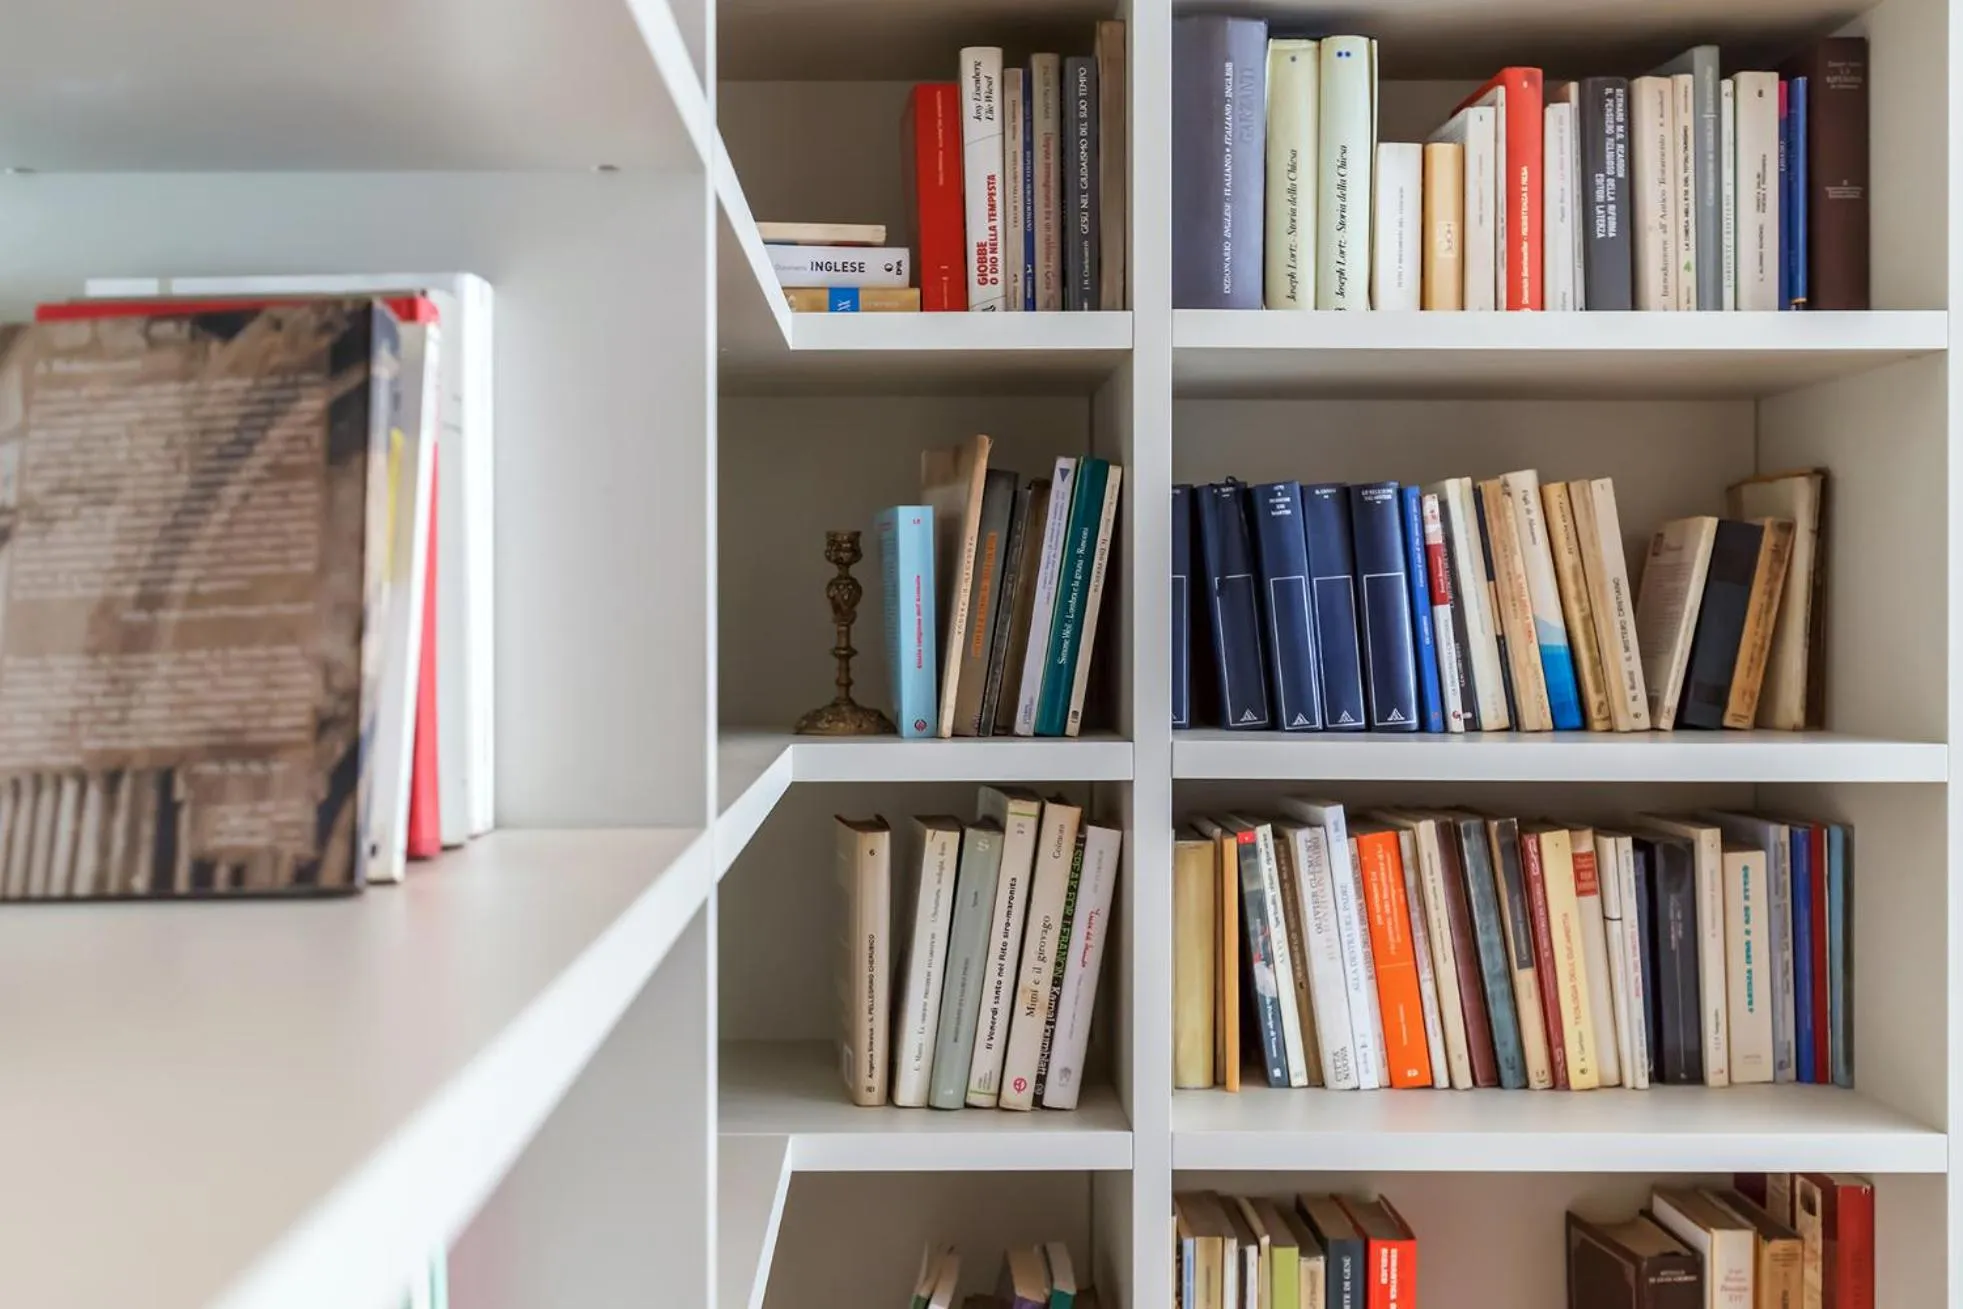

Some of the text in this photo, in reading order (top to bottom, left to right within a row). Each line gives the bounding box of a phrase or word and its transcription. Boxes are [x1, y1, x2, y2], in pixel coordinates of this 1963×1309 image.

[984, 75, 994, 121] Elie Wiesel
[1615, 88, 1624, 122] BERNARD
[1605, 98, 1614, 135] PENSIERO
[1078, 67, 1088, 209] NEL GIUDAISMO DEL SUO TEMPO
[1605, 137, 1615, 175] RELIGIOSO
[1616, 143, 1625, 178] REARDON
[1223, 62, 1233, 294] DIZIONARIO INGLESE ITALIANO ITALIANO INGLESE
[1606, 178, 1616, 201] DELLA
[987, 174, 997, 222] TEMPESTA
[1595, 173, 1605, 238] EDITORI LATERZA
[1286, 149, 1298, 302] Joseph Lortz Storia della Chiesa
[1335, 144, 1348, 298] Joseph Lortz Storia della Chiesa
[1607, 203, 1616, 238] RIFORMA
[988, 225, 998, 254] NELLA
[810, 261, 866, 273] INGLESE
[976, 241, 988, 286] GIOBBE
[990, 256, 998, 274] DIO
[1076, 527, 1089, 555] Rusconi
[1073, 559, 1083, 581] grazia
[1613, 577, 1626, 617] CRISTIANO
[1061, 622, 1073, 638] Weil
[1619, 619, 1631, 653] MISTERO
[1057, 639, 1070, 665] Simone
[1001, 877, 1018, 939] siro-maronita
[1311, 891, 1323, 934] OLIVIER
[867, 933, 875, 972] CHERUBICO
[998, 941, 1009, 961] Rito
[1034, 915, 1053, 963] girovago
[996, 963, 1005, 978] nel
[1031, 966, 1043, 975] il
[867, 973, 875, 1015] PELLEGRINO
[992, 980, 1002, 1005] santo
[1569, 984, 1581, 1026] TEOLOGIA
[987, 1007, 999, 1041] Venerdì
[866, 1052, 875, 1079] Angelus
[1342, 1280, 1351, 1290] DI
